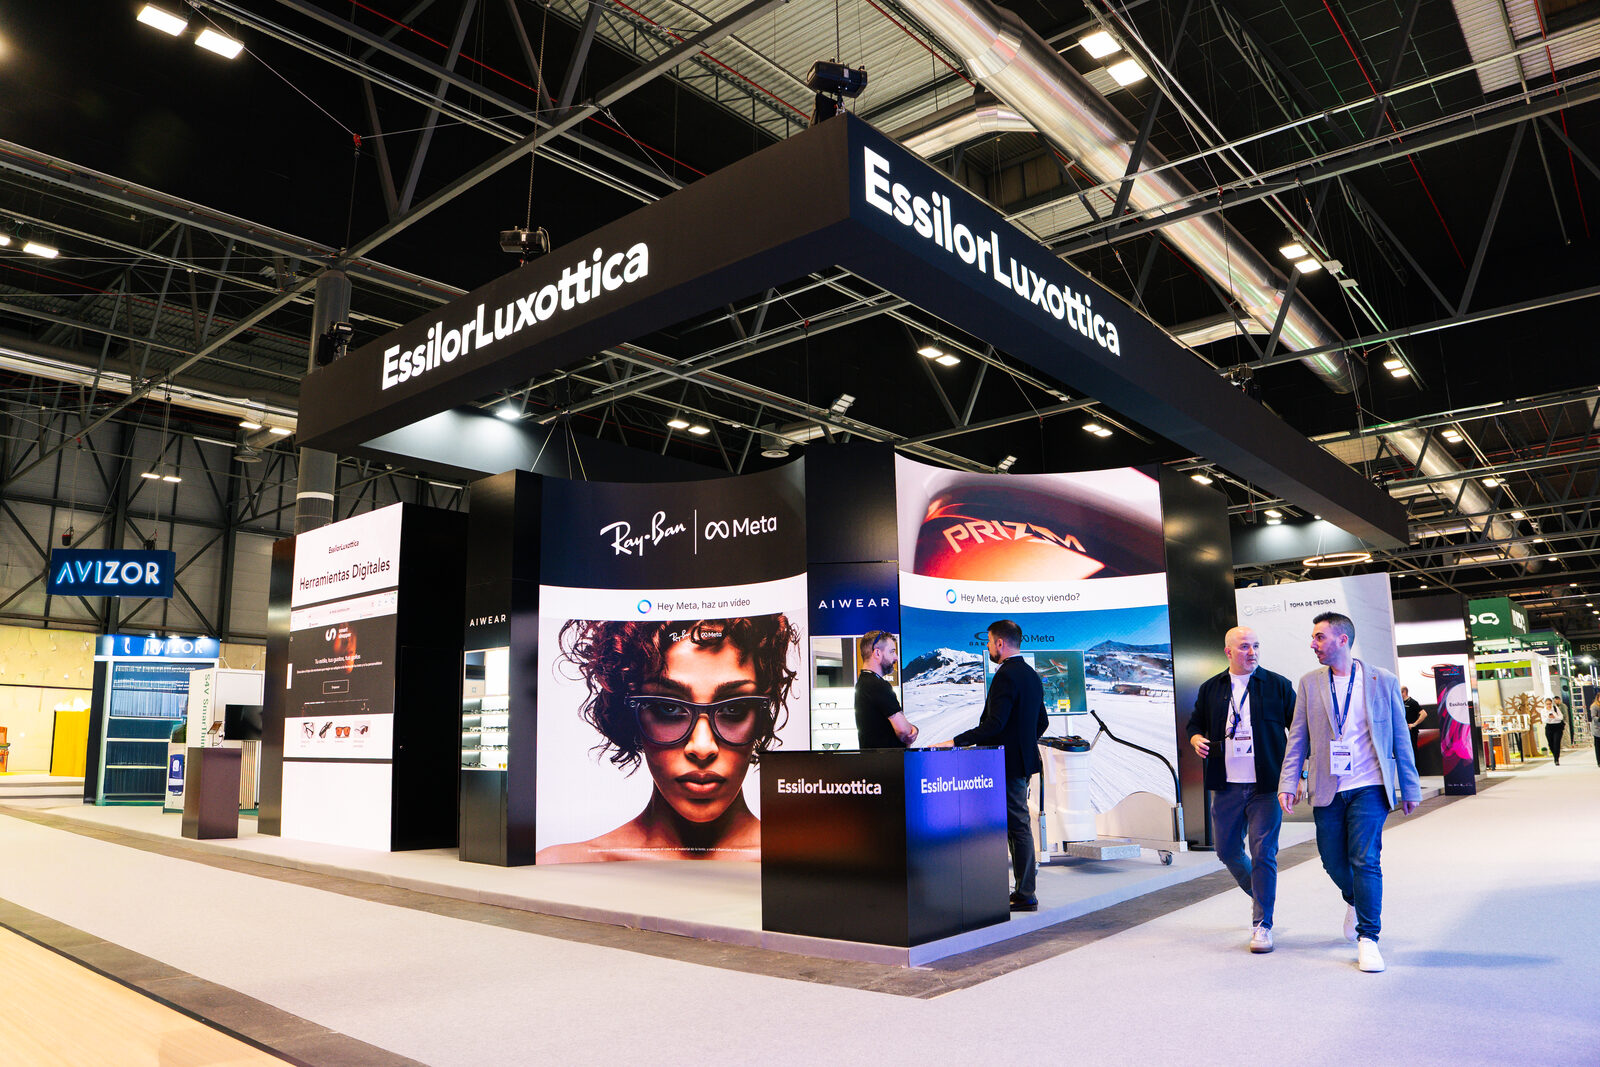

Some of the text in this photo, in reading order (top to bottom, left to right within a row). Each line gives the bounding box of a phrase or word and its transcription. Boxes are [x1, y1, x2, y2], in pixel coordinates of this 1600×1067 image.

[864, 146, 1121, 357] EssilorLuxottica
[382, 242, 649, 391] EssilorLuxottica
[733, 516, 777, 538] Meta
[943, 520, 1087, 553] PRIZM
[328, 540, 360, 554] EssilorLuxottica
[56, 560, 160, 584] AVIZOR
[299, 557, 390, 591] Herramientas Digitales
[657, 602, 674, 613] Hey
[676, 602, 700, 610] Meta,
[701, 600, 716, 609] haz
[818, 597, 890, 609] AIWEAR
[960, 592, 1081, 605] Hey Meta, ¿qué estoy viendo?
[1313, 598, 1336, 606] MEDIDAS
[469, 614, 506, 627] AIWEAR
[1031, 634, 1055, 643] Meta
[777, 778, 882, 795] EssilorLuxottica
[921, 774, 994, 794] EssilorLuxottica
